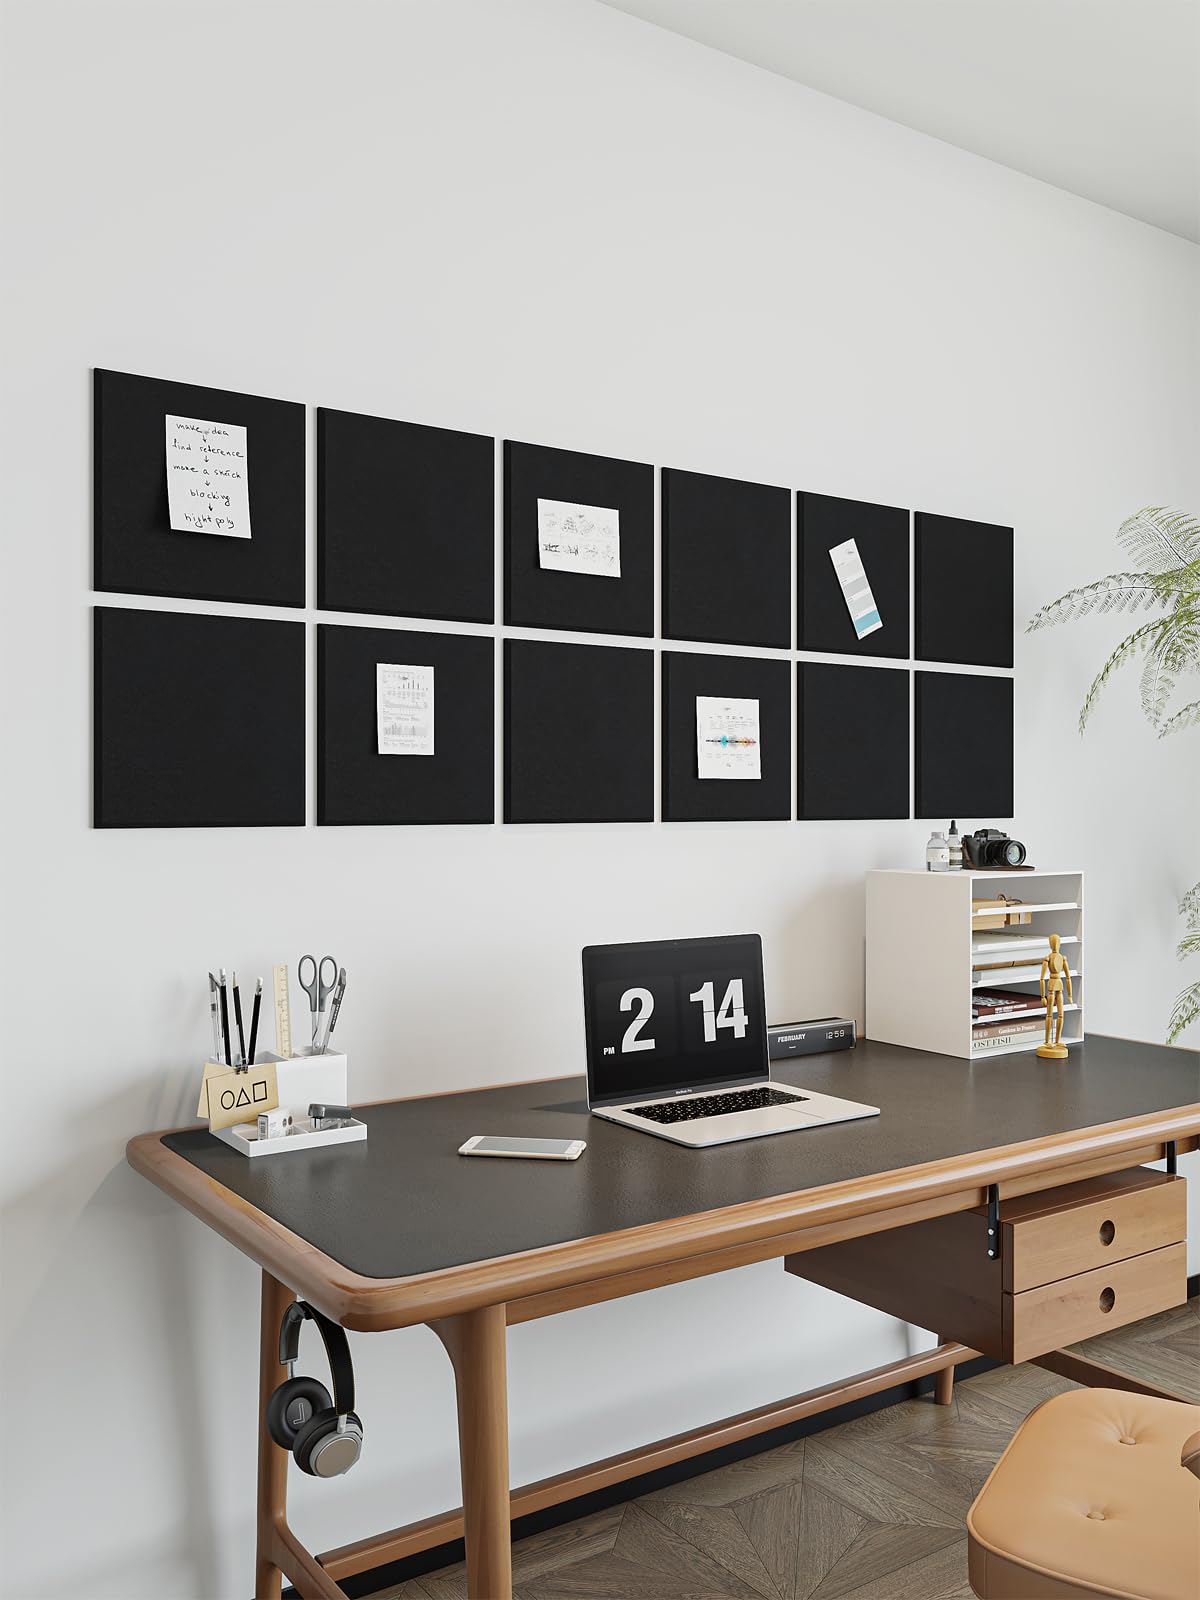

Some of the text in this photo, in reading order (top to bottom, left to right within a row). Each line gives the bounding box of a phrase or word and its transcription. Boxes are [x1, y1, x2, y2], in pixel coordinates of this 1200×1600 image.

[172, 438, 244, 458] find reference
[190, 489, 230, 506] blocking
[619, 978, 749, 1053] 2 14
[777, 1033, 806, 1043] FEBRUARY
[992, 1036, 1011, 1046] FISH
[603, 1046, 615, 1056] PM
